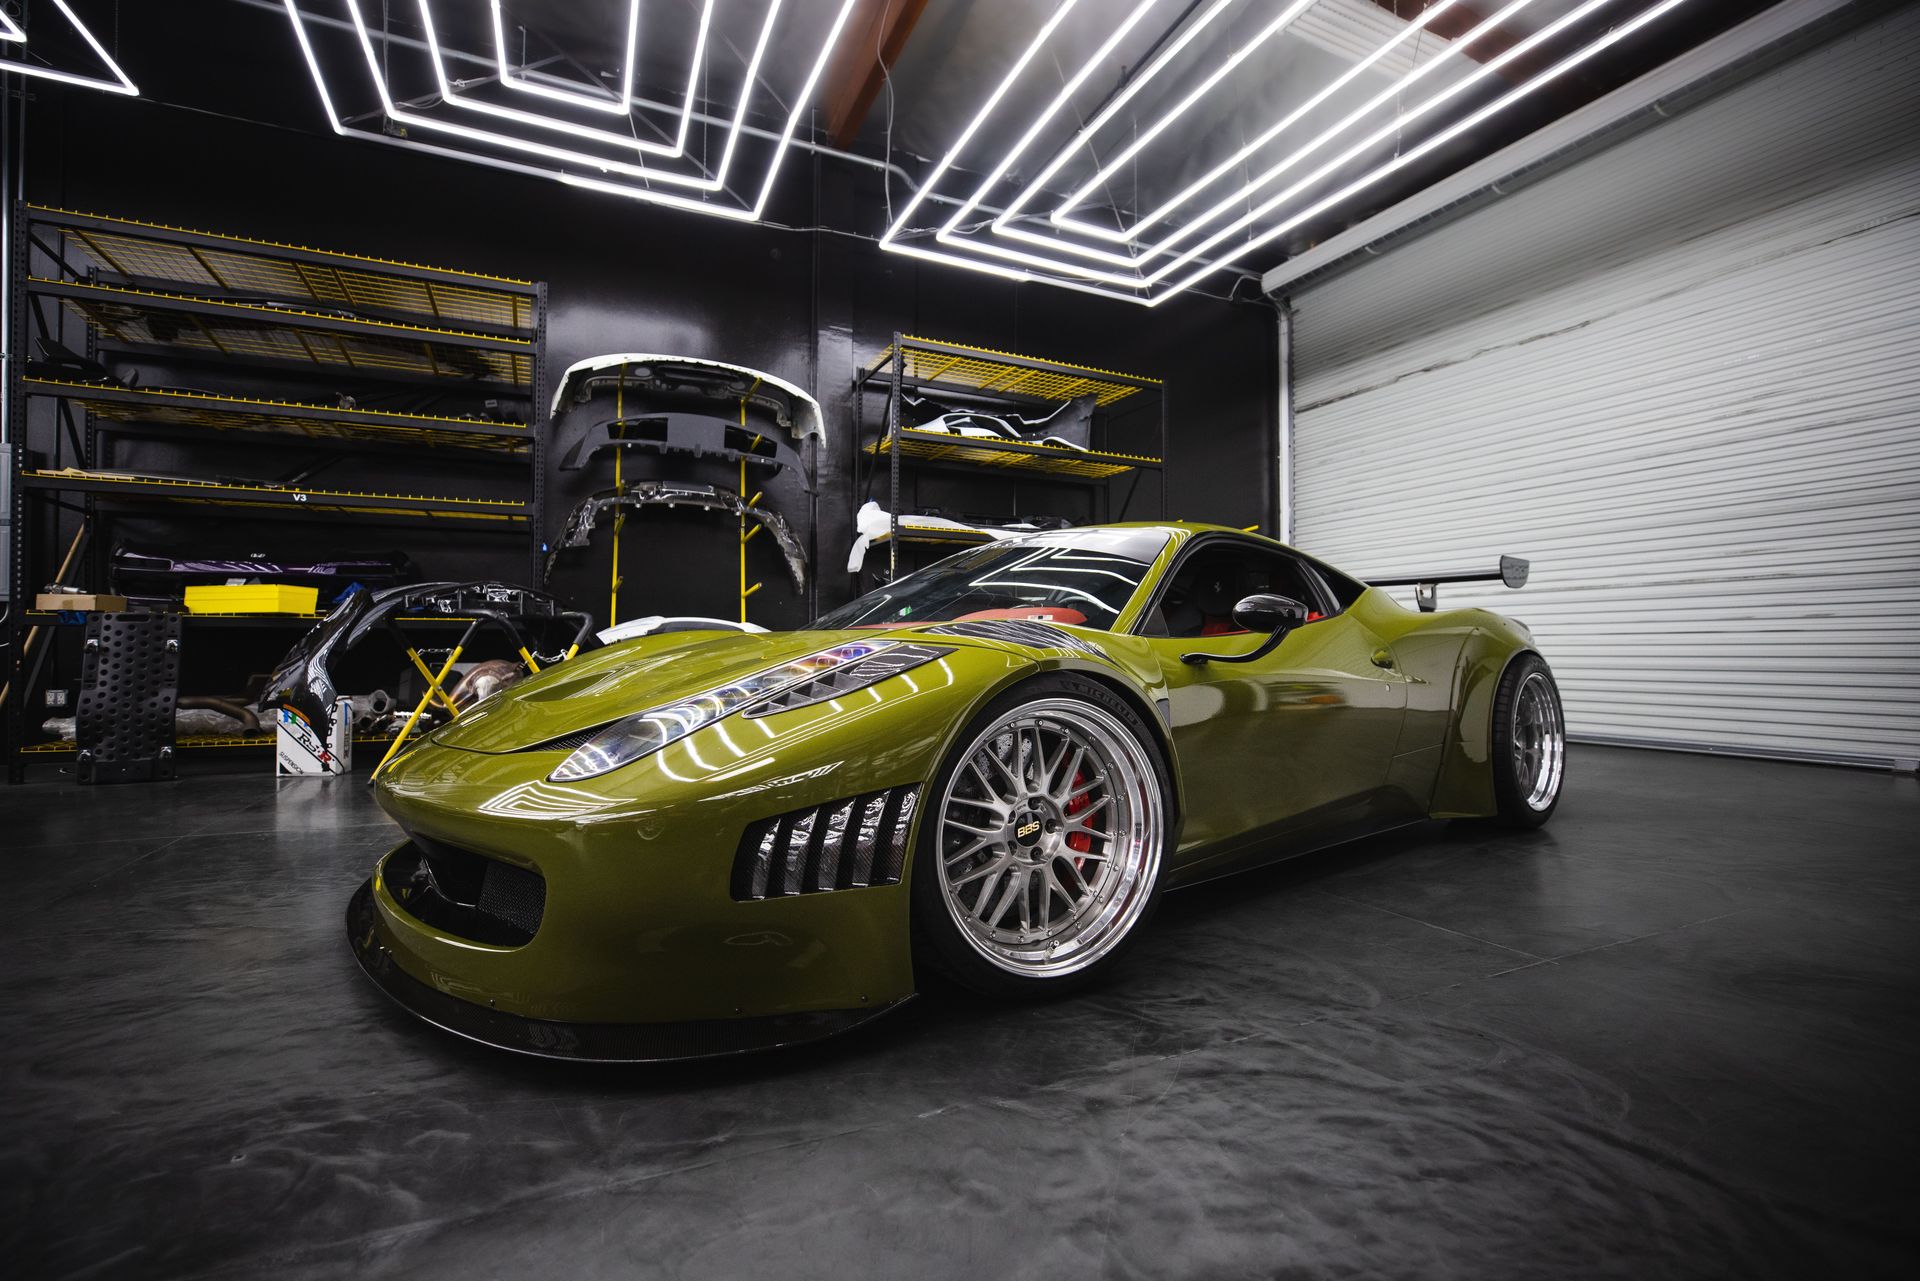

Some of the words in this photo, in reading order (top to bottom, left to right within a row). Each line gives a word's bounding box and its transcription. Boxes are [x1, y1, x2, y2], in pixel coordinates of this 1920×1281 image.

[293, 493, 306, 501] V3
[280, 751, 304, 774] SUSPENSION
[1017, 820, 1040, 839] BBS
